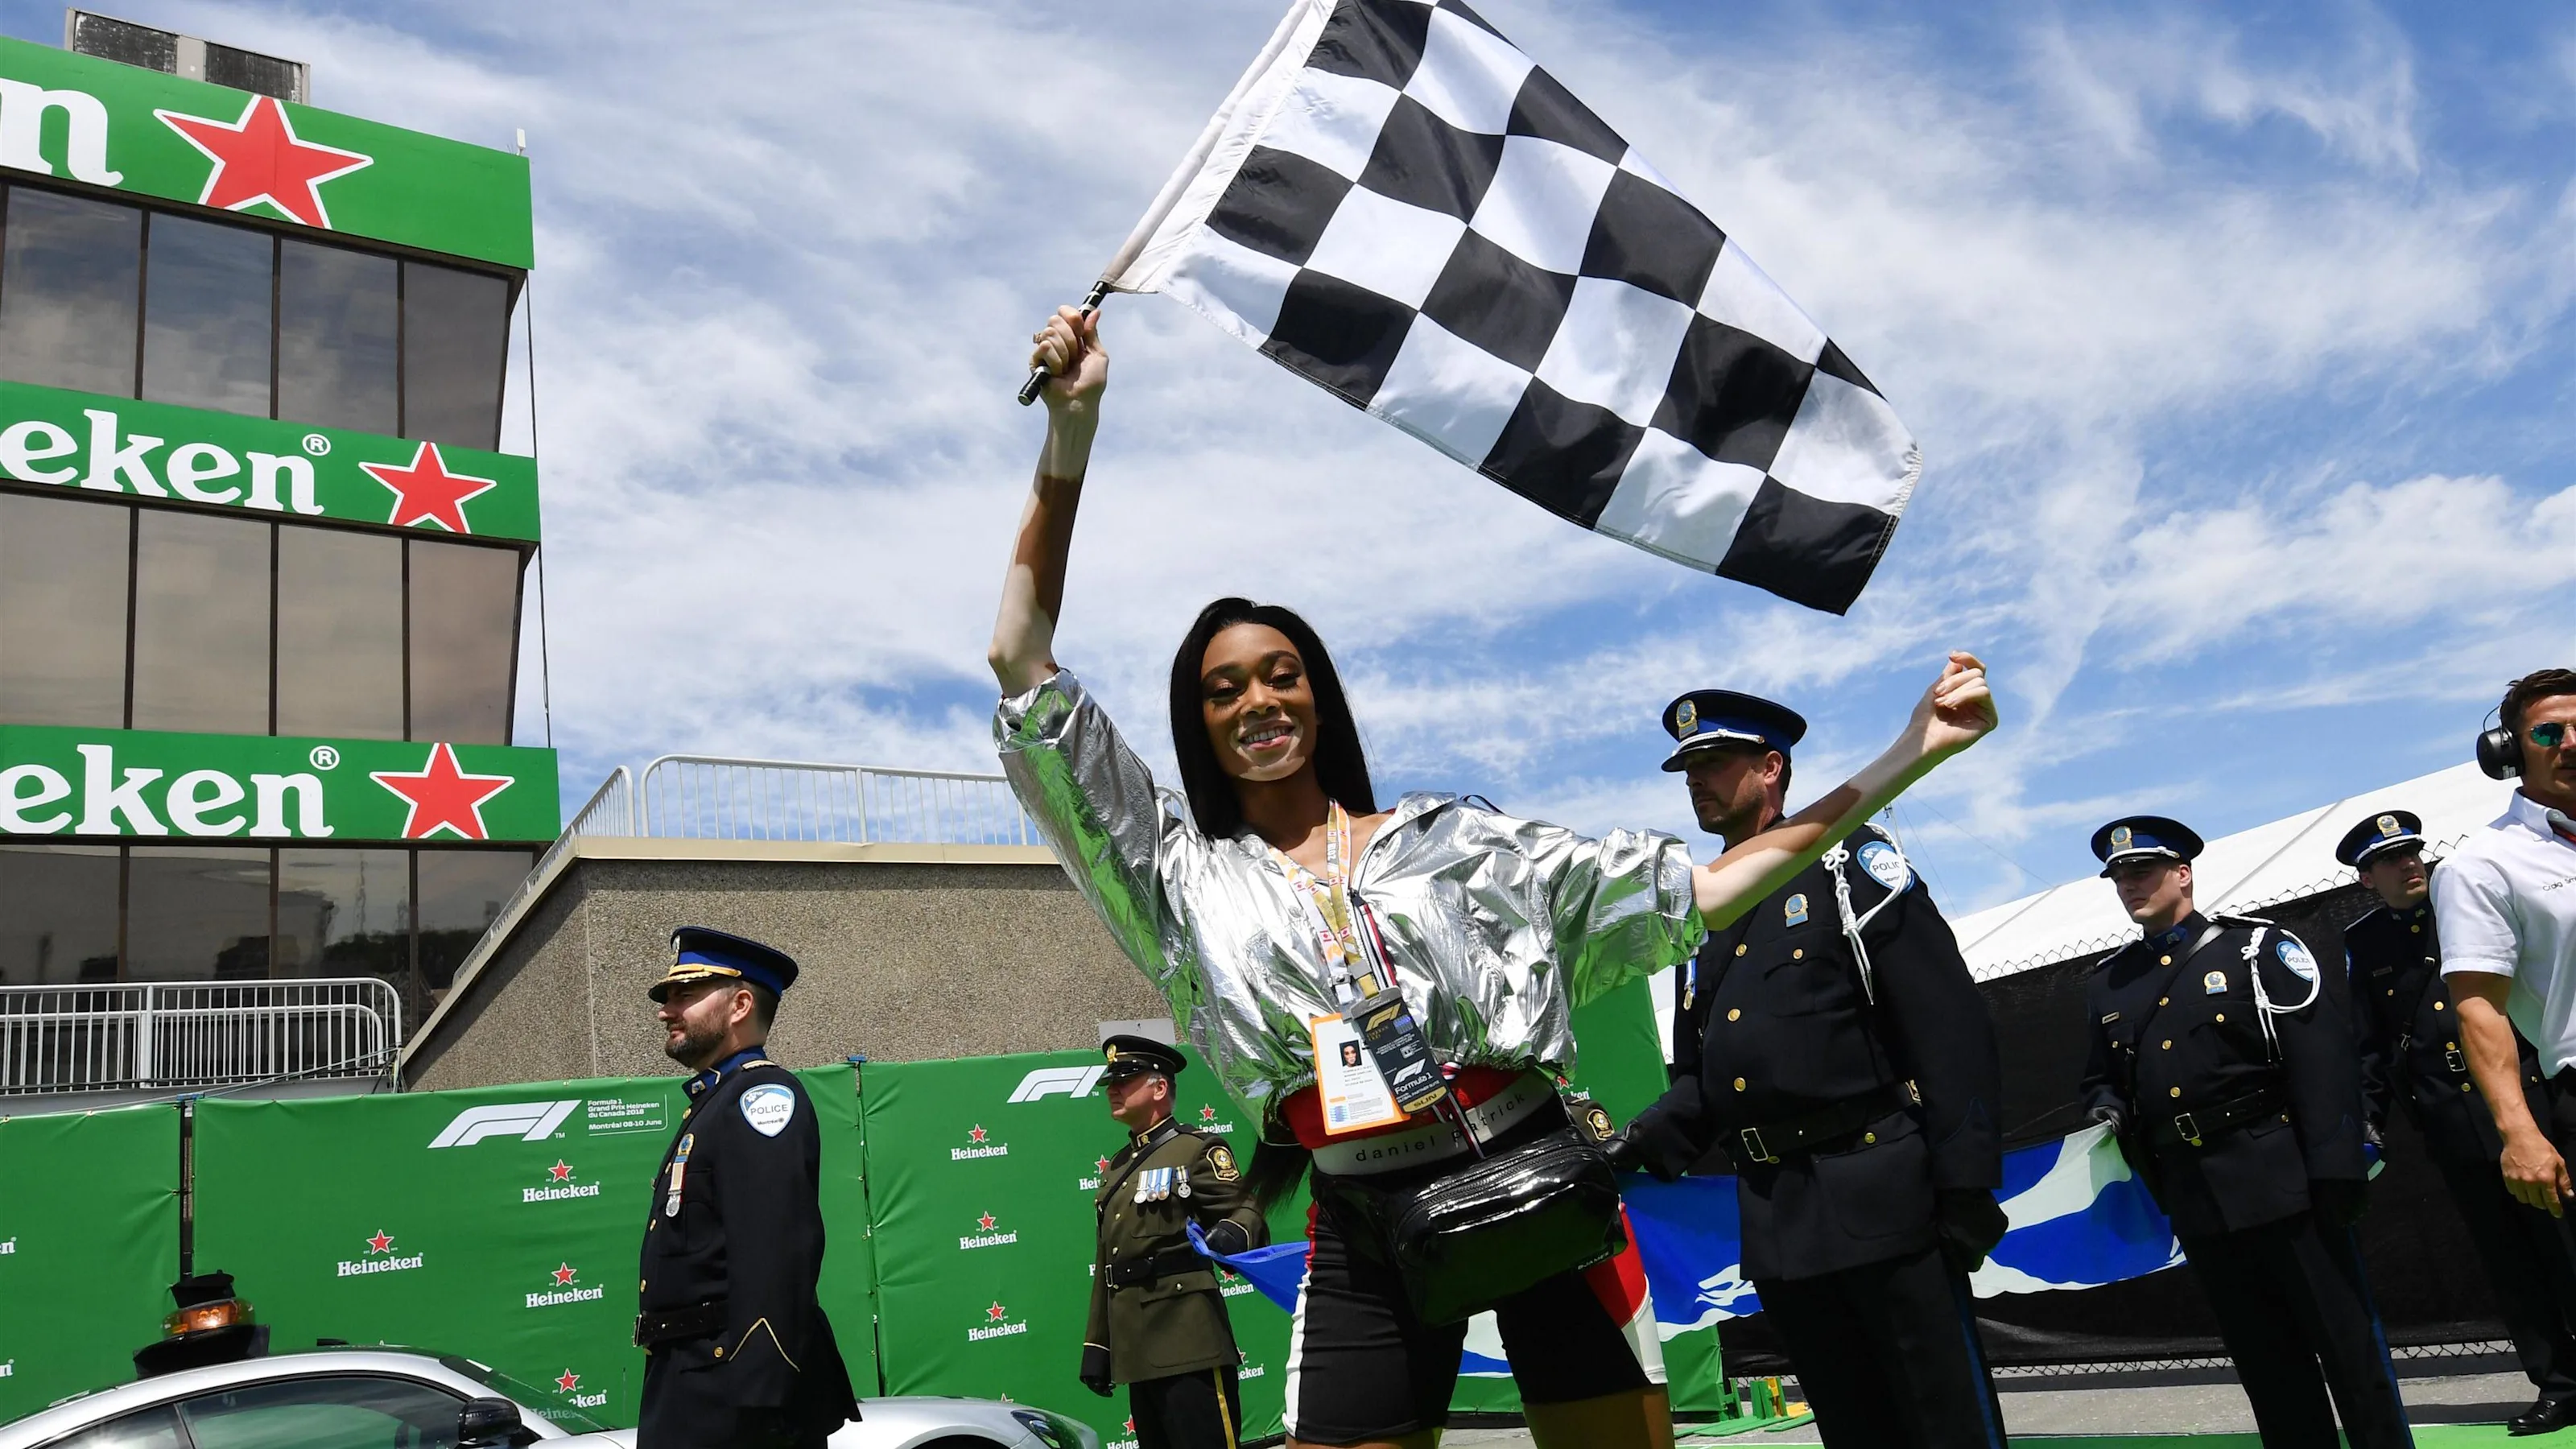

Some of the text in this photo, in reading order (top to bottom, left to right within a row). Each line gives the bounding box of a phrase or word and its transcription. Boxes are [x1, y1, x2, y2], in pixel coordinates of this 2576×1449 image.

[1394, 1071, 1433, 1095] Formula 1
[587, 1099, 617, 1107] Formula
[588, 1104, 610, 1113] Grand
[749, 1104, 789, 1116] POLICE
[588, 1121, 622, 1130] Montréal
[1355, 1092, 1526, 1162] daniel patrick
[951, 1143, 1008, 1160] Heineken
[522, 1181, 600, 1203] Heineken
[960, 1229, 1018, 1249] Heineken
[336, 1252, 423, 1278] Heineken
[525, 1284, 604, 1308] Heineken
[968, 1319, 1027, 1342] Heineken
